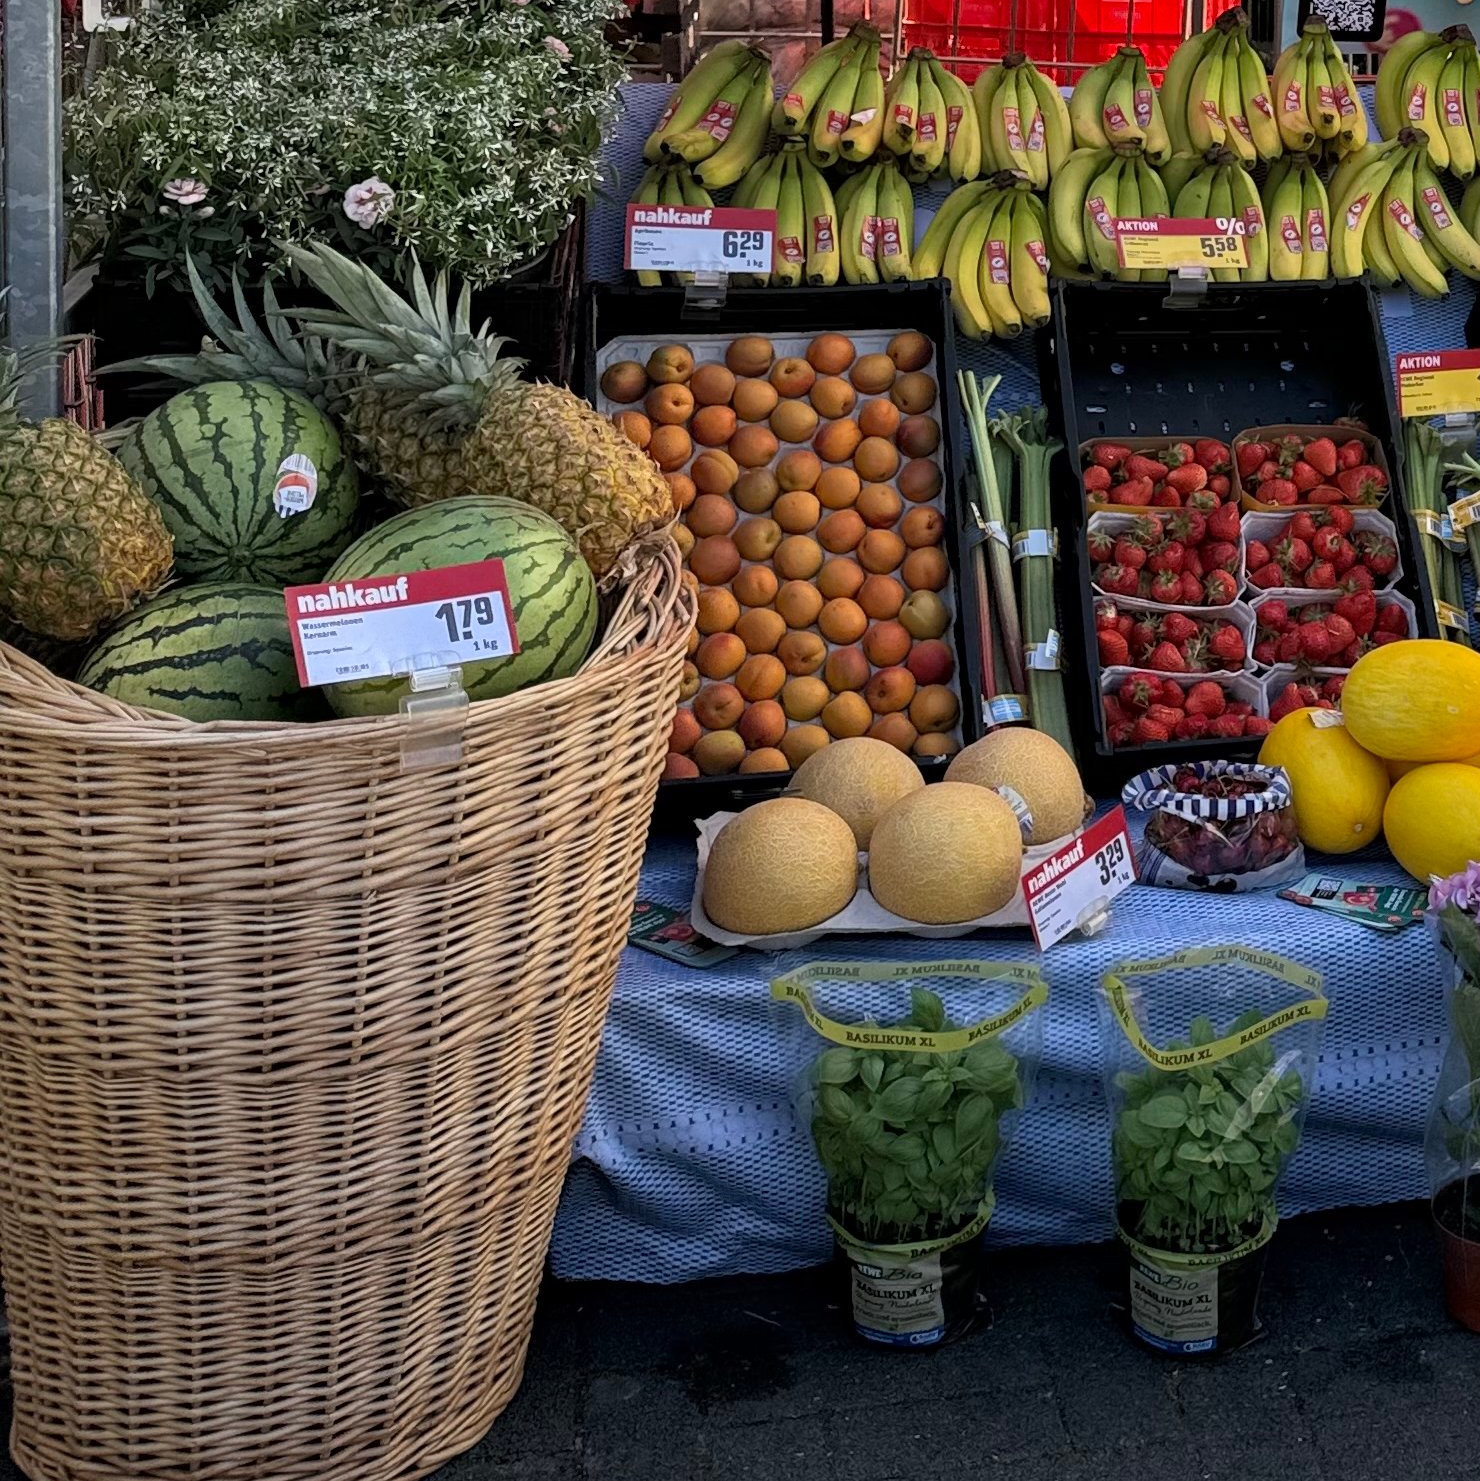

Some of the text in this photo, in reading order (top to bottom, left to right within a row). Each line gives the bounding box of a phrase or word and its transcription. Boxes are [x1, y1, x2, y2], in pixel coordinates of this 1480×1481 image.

[634, 207, 713, 226] nahkauf
[1117, 221, 1159, 232] AKTION
[1400, 355, 1441, 369] AKTION
[297, 576, 409, 614] nahkauf
[483, 638, 499, 651] kg
[1027, 838, 1085, 894] nahkauf
[1296, 1005, 1312, 1018] XL
[846, 1030, 936, 1048] BASILIKUM XL
[1197, 1048, 1213, 1060] XL
[855, 1279, 937, 1300] BASILIKUM XL
[1164, 1273, 1199, 1290] Bio
[1134, 1280, 1212, 1307] BASILIKUM XL
